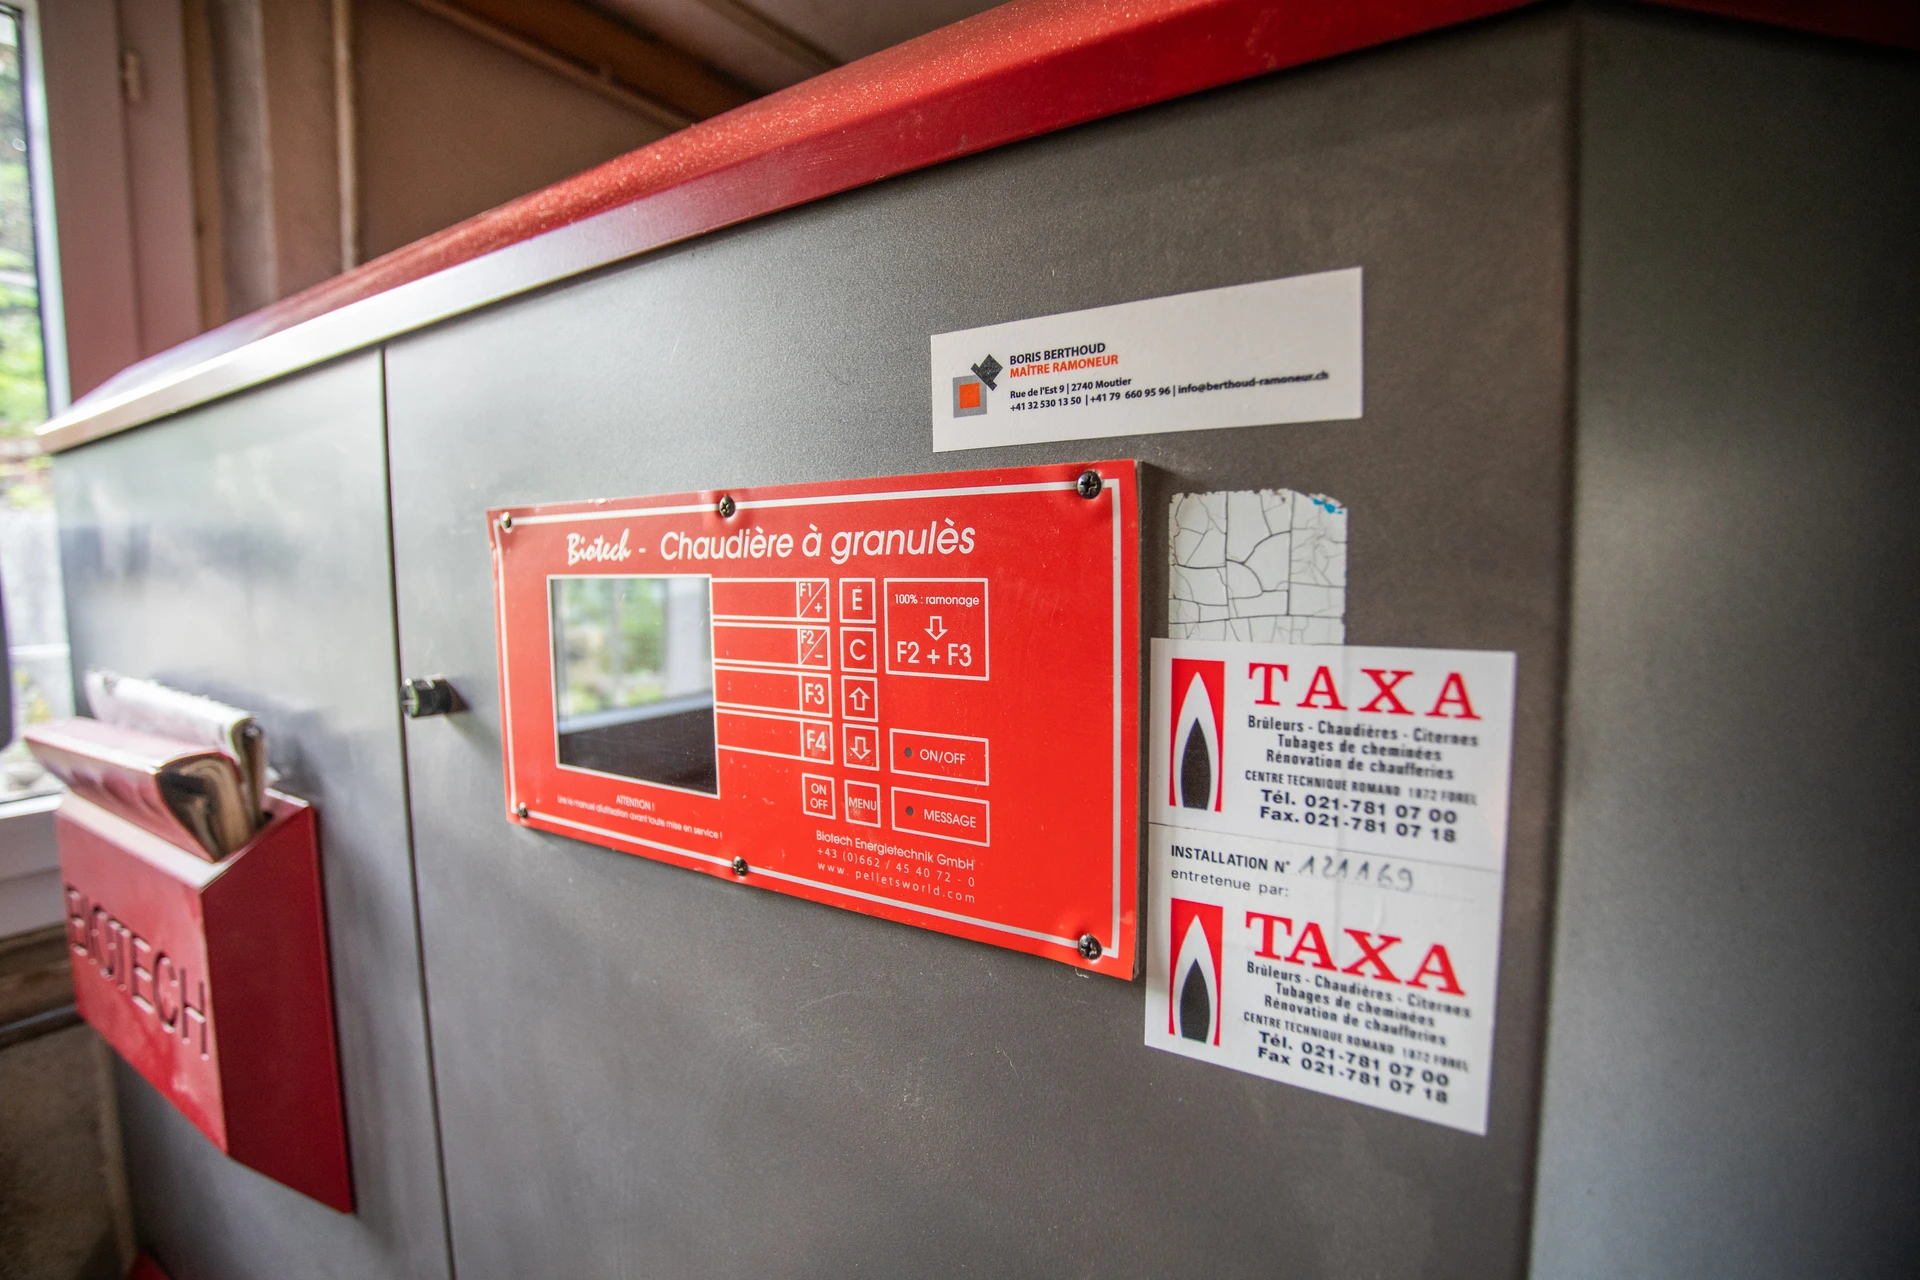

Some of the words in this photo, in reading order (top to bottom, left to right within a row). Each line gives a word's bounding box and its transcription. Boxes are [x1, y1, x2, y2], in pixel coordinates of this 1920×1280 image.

[1010, 352, 1041, 365] BORIS
[1044, 342, 1106, 361] BERTHOUD
[1010, 361, 1050, 378] MAÎTRE
[1053, 354, 1119, 373] RAMONEUR
[1010, 390, 1026, 399] Rue
[1027, 388, 1039, 397] de
[1040, 386, 1058, 395] l'Est
[1059, 385, 1065, 394] 9
[1071, 381, 1093, 392] 2740
[1095, 377, 1132, 389] Moutier
[1010, 402, 1026, 412] +41
[1028, 400, 1039, 410] 32
[1040, 399, 1056, 409] 530
[1059, 397, 1069, 407] 13
[1070, 396, 1081, 405] 50
[1090, 393, 1107, 403] +41
[1110, 391, 1121, 401] 79
[1125, 389, 1142, 399] 660
[1144, 388, 1156, 398] 95
[1159, 386, 1171, 396] 96
[566, 528, 632, 567] Biotech
[660, 525, 794, 561] Chaudière
[801, 524, 822, 557] à
[830, 517, 976, 566] granulès
[800, 583, 812, 597] F1
[895, 594, 918, 604] 100%
[926, 596, 980, 608] ramonage
[801, 629, 815, 645] F2
[849, 639, 867, 661] C
[897, 641, 920, 664] F2
[948, 643, 972, 667] F3
[805, 683, 825, 705] F3
[1248, 662, 1482, 721] TAXA
[806, 729, 827, 752] F4
[1248, 715, 1304, 733] Brûleurs
[1317, 720, 1399, 740] Chaudières
[1413, 727, 1478, 747] Citernes
[919, 749, 966, 765] ON/OFF
[1278, 733, 1334, 753] Tubages
[1339, 740, 1356, 753] de
[1361, 742, 1442, 761] cheminées
[1266, 749, 1342, 769] Rénovation
[1347, 757, 1364, 771] de
[1369, 760, 1454, 780] chaufferies
[811, 783, 827, 796] ON
[1245, 770, 1283, 785] CENTRE
[1287, 774, 1347, 792] TECHNIQUE
[1351, 781, 1401, 797] ROMAND
[616, 795, 652, 811] ATTENTION
[810, 798, 828, 810] OFF
[848, 797, 878, 811] MENU
[1261, 788, 1296, 806] Tél.
[1304, 794, 1386, 816] 021-781
[1395, 804, 1421, 820] 07
[1428, 807, 1457, 824] 00
[666, 820, 682, 831] mise
[683, 825, 692, 833] en
[694, 827, 719, 839] service
[924, 809, 977, 829] MESSAGE
[1260, 806, 1299, 823] Fax.
[1304, 811, 1386, 834] 021-781
[1395, 822, 1421, 838] 07
[1431, 827, 1456, 843] 18
[816, 830, 853, 846] Biotech
[855, 835, 934, 864] Energietechnik
[937, 854, 974, 871] GmbH
[1171, 844, 1268, 872] INSTALLATION
[817, 847, 838, 858] +43
[843, 851, 880, 867] (0)662
[896, 863, 910, 874] 45
[916, 867, 930, 878] 40
[937, 871, 951, 882] 72
[968, 877, 975, 888] 0
[1171, 869, 1251, 891] entretenue
[1259, 883, 1289, 897] par:
[1245, 910, 1466, 997] TAXA
[64, 884, 210, 1062] BIOTECH
[1247, 960, 1301, 984] Brûleurs
[1315, 975, 1393, 1002] Chaudières
[1276, 982, 1330, 1006] Tubages
[1335, 996, 1351, 1009] de
[1357, 1001, 1435, 1027] cheminées
[1243, 1011, 1281, 1029] CENTRE
[1285, 1020, 1343, 1044] TECHNIQUE
[1346, 1035, 1395, 1054] ROMAND
[1264, 995, 1338, 1021] Rénovation
[1343, 1013, 1359, 1027] de
[1364, 1019, 1447, 1046] chaufferies
[1259, 1031, 1293, 1050] Tél.
[1301, 1042, 1380, 1070] 021-781
[1389, 1062, 1414, 1078] 07
[1421, 1069, 1449, 1087] 00
[1257, 1046, 1291, 1066] Fax
[1301, 1058, 1381, 1088] 021-781
[1389, 1079, 1415, 1095] 07
[1424, 1088, 1448, 1104] 18
